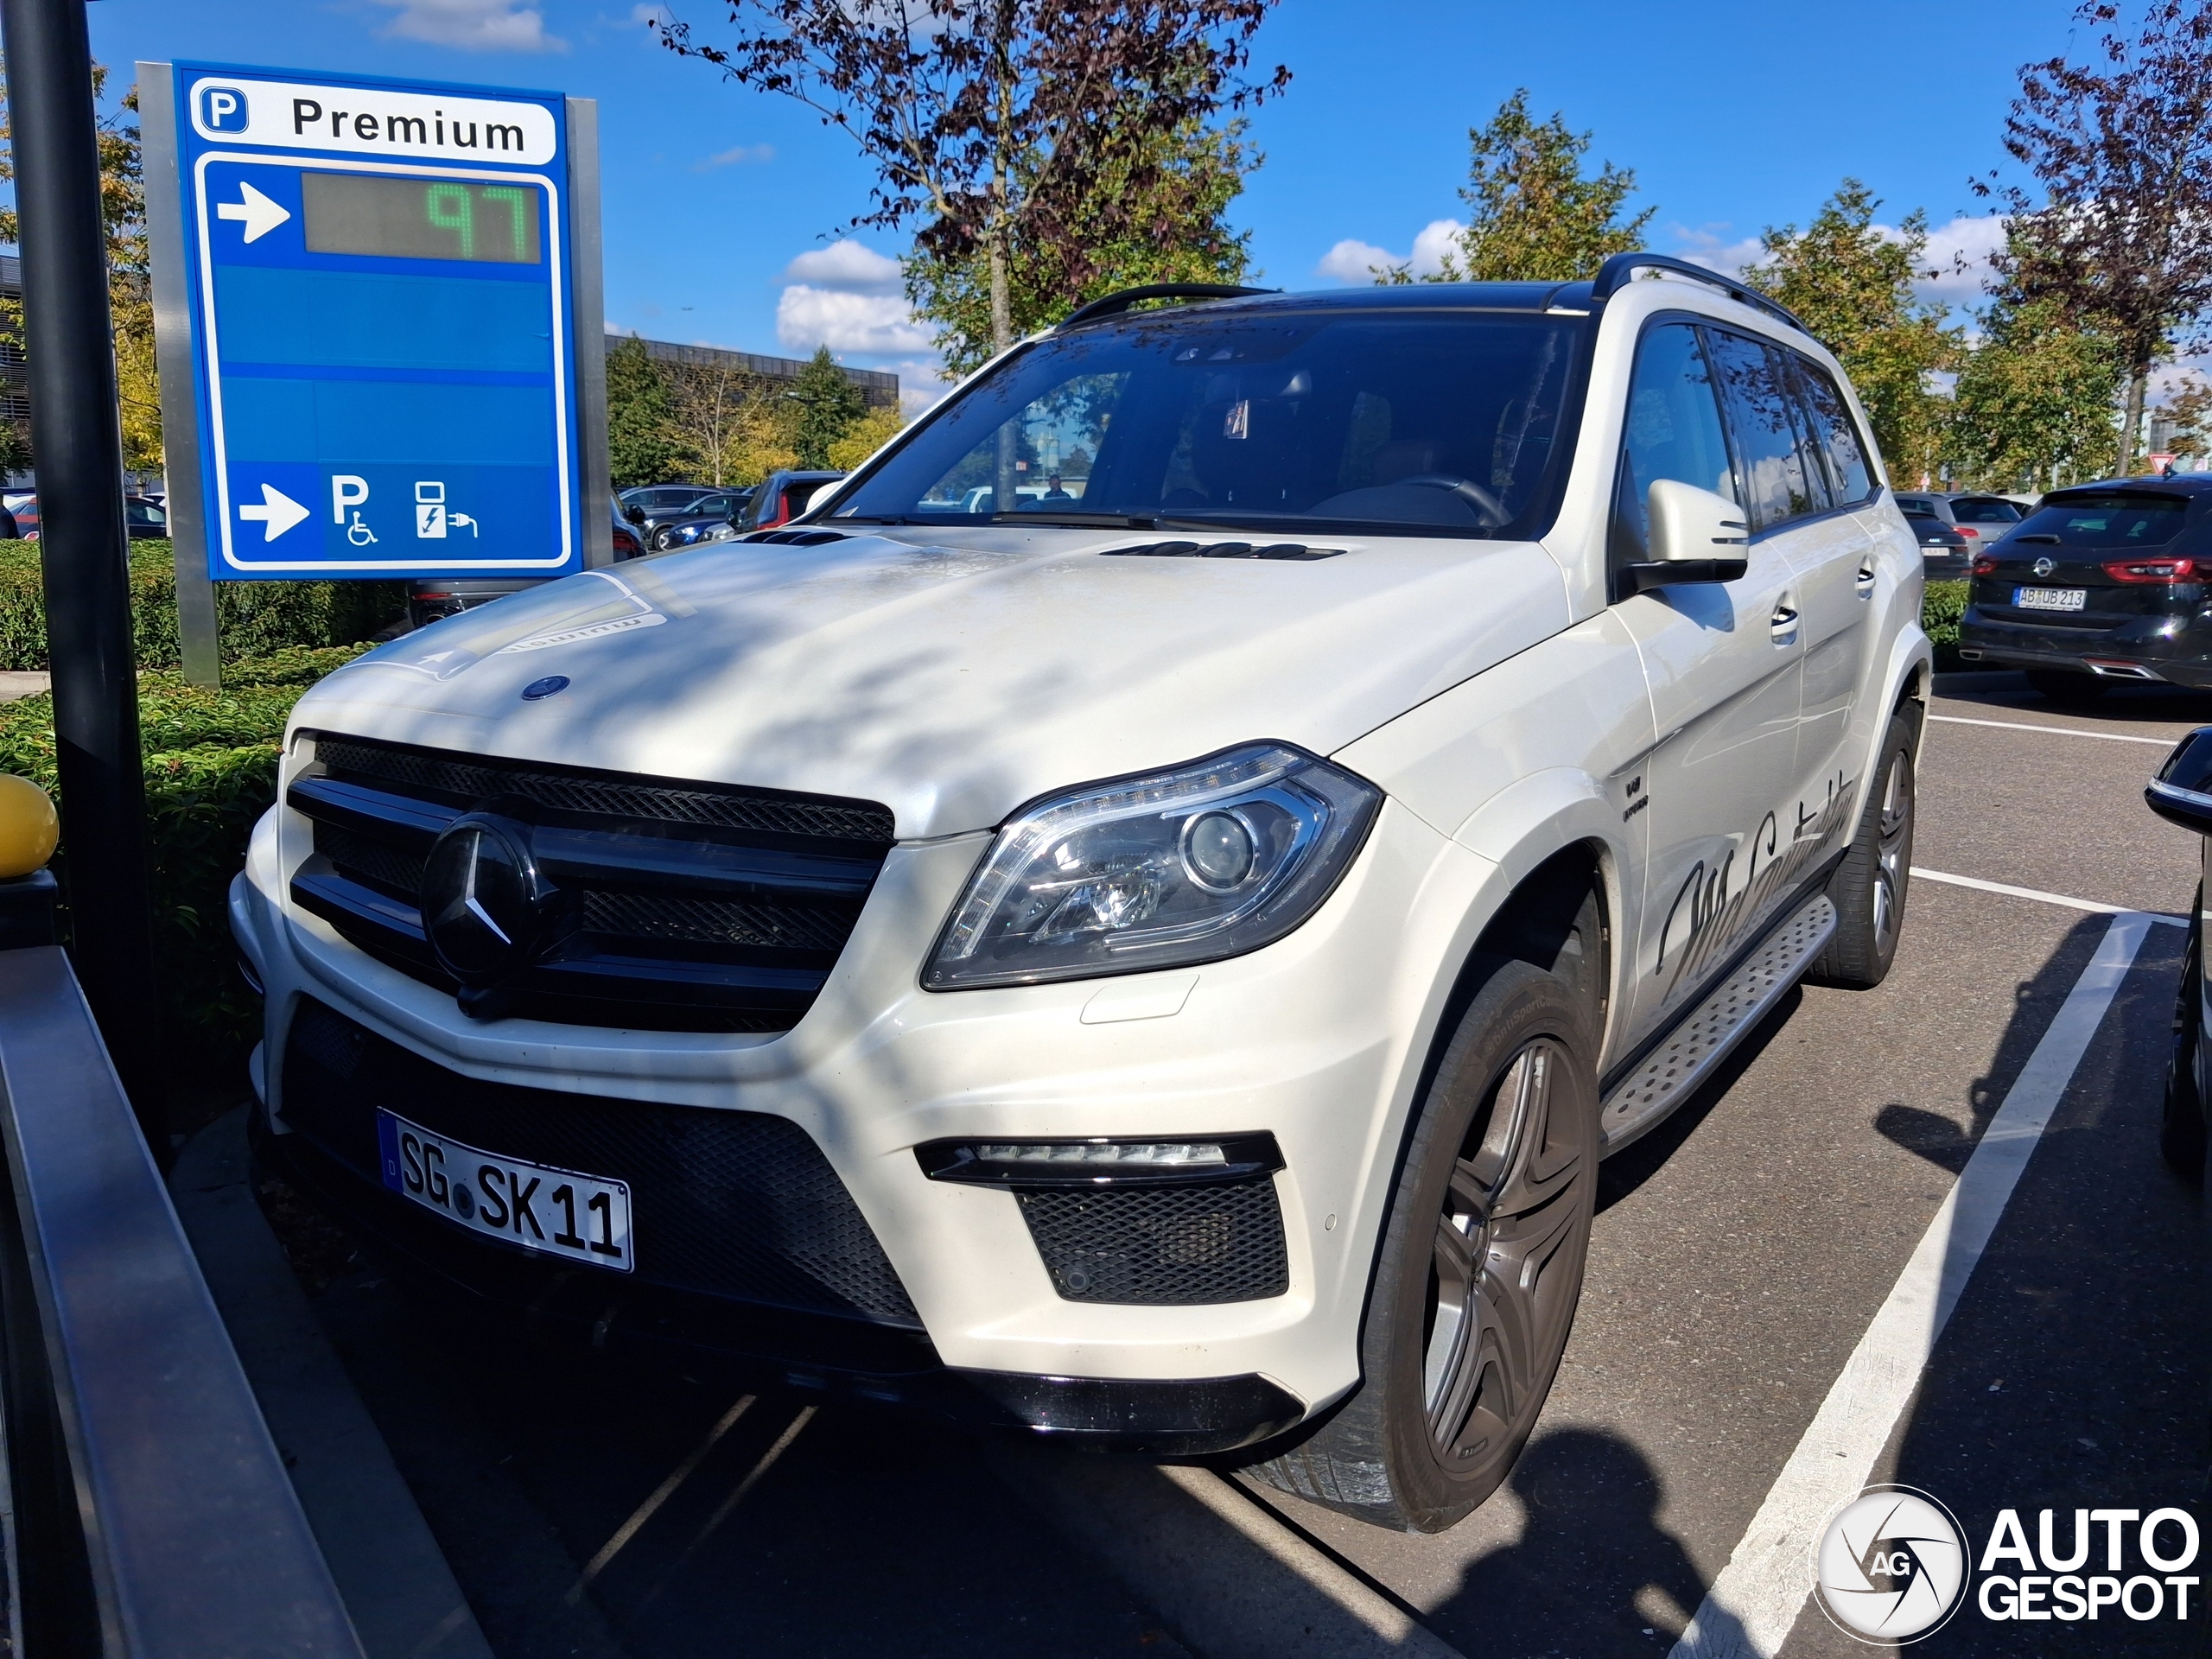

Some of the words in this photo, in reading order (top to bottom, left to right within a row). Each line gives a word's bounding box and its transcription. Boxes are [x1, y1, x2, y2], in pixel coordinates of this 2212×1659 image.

[211, 92, 238, 127] P
[293, 98, 525, 152] Premium
[427, 183, 526, 261] 97
[331, 474, 370, 525] P
[401, 1131, 452, 1209] SG
